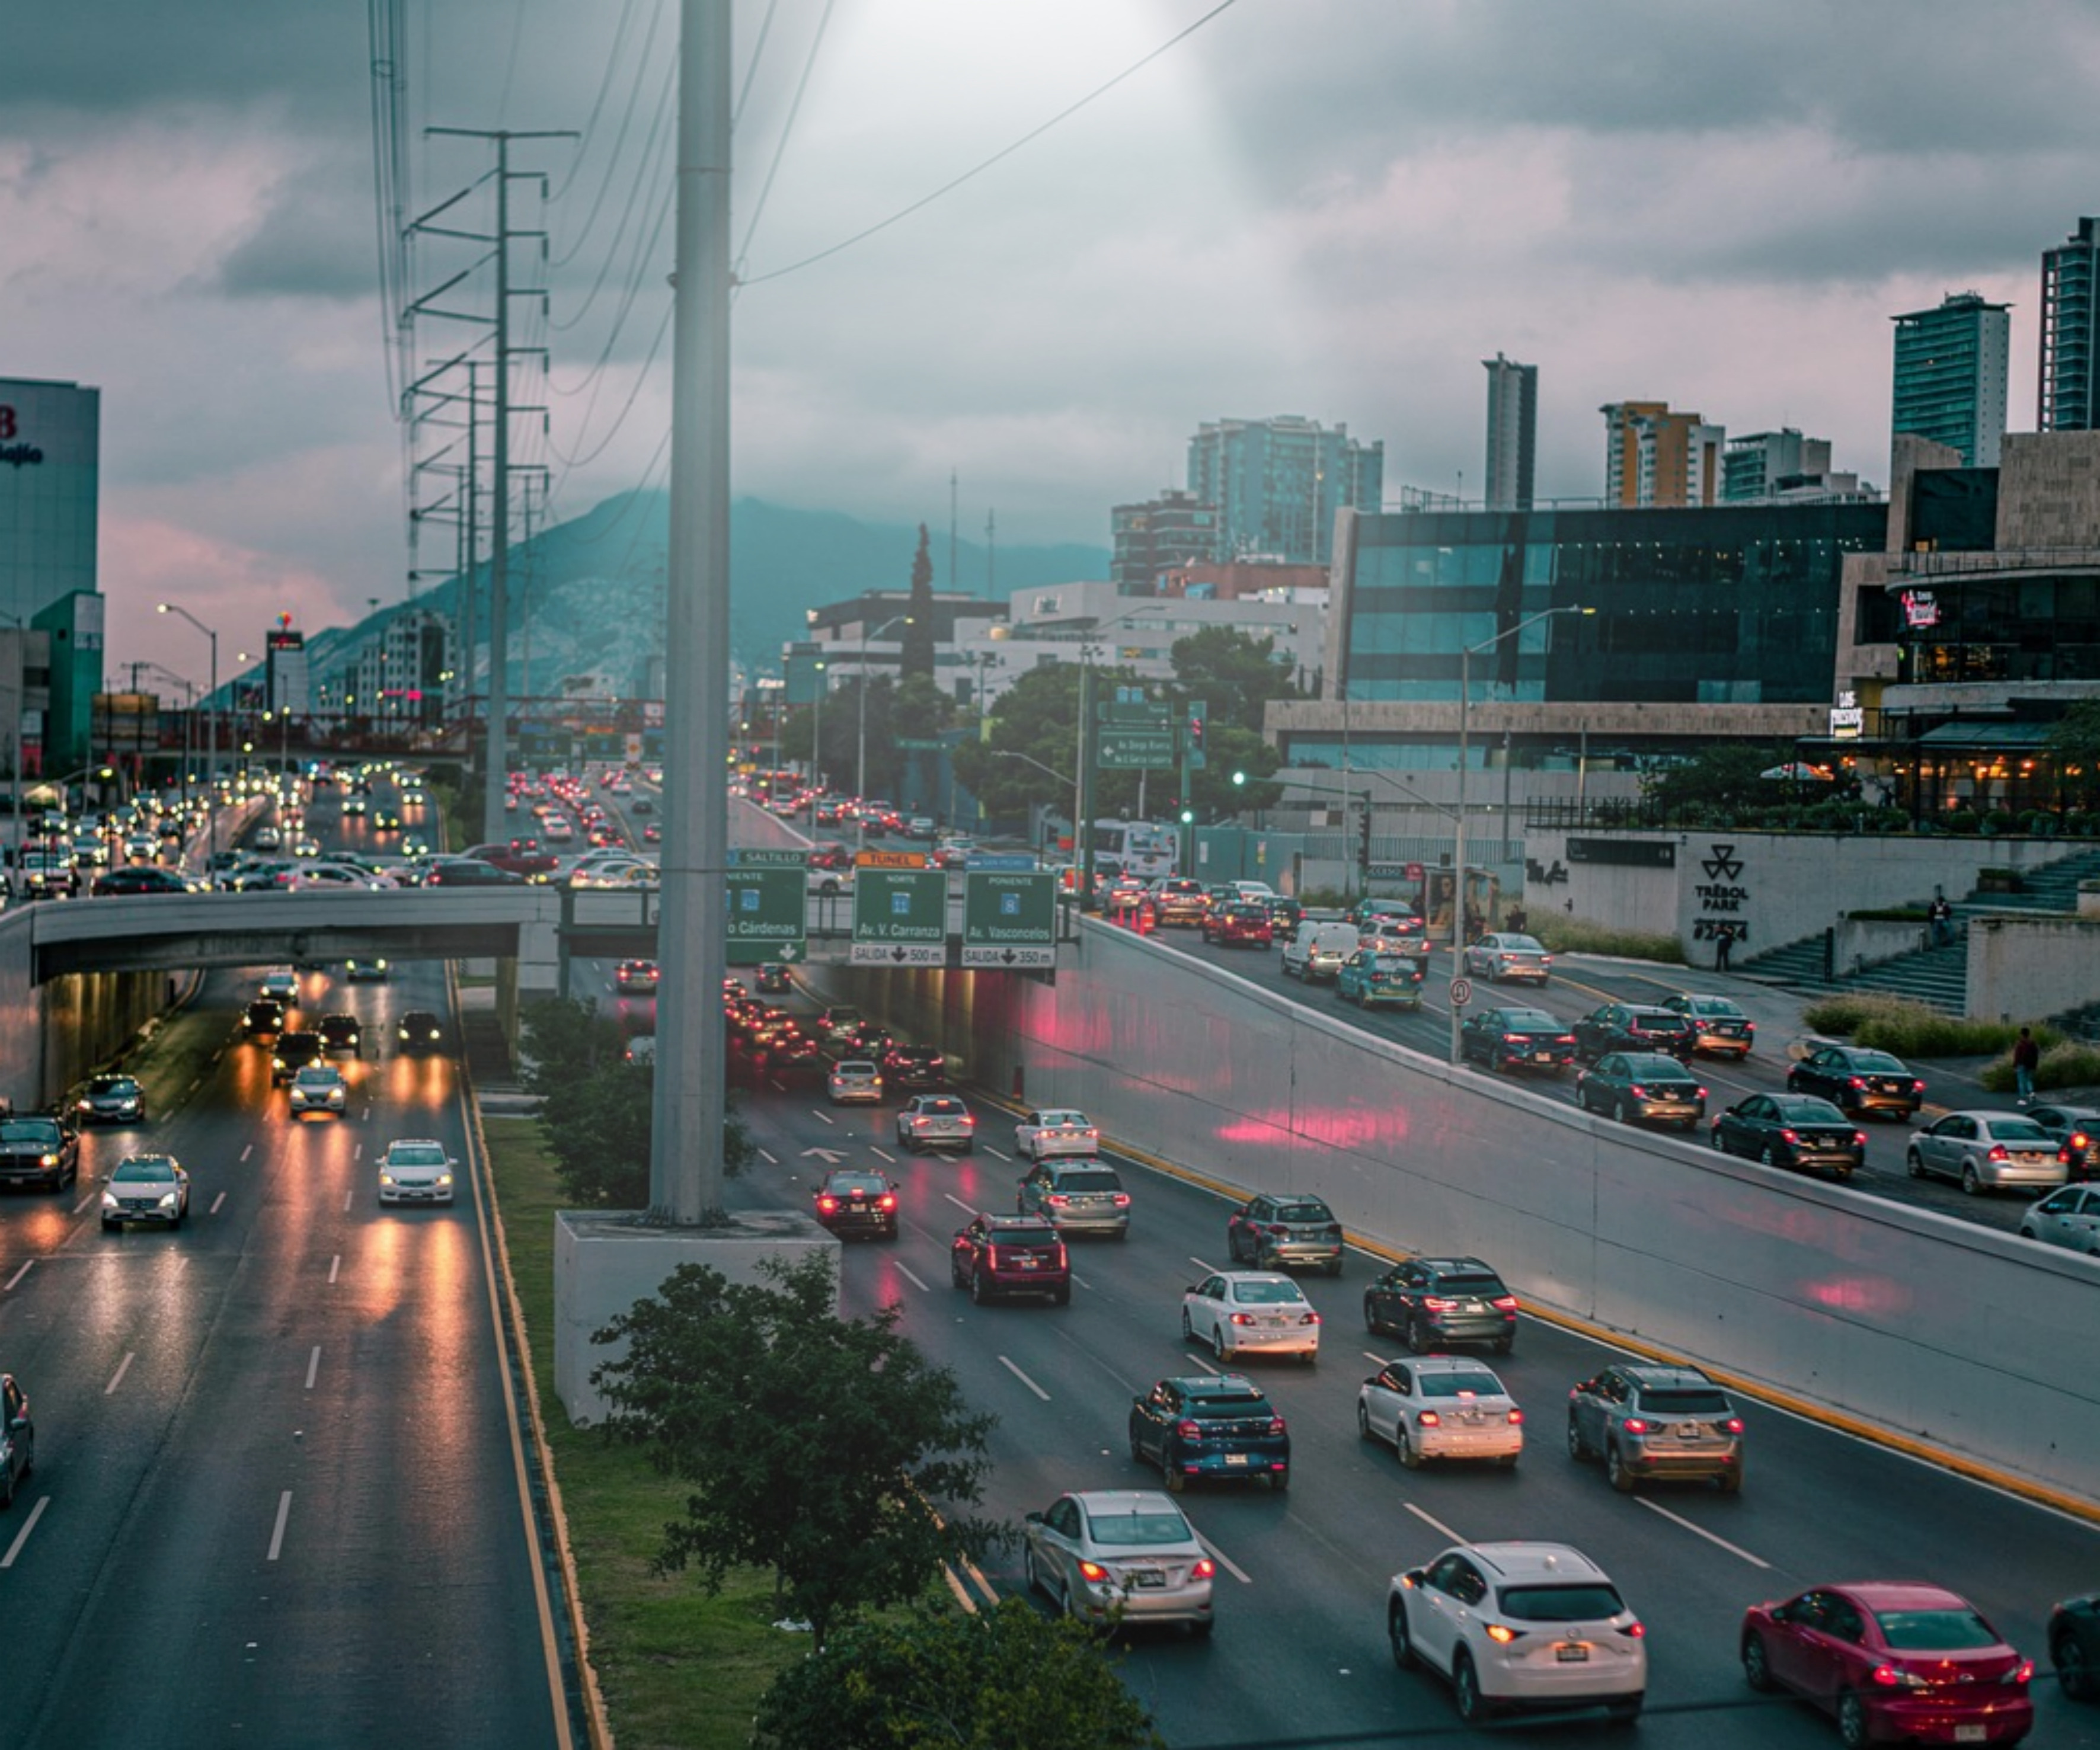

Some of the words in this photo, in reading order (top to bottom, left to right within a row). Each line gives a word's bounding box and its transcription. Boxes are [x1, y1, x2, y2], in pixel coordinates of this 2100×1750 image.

[746, 852, 801, 862] SALTILLO
[726, 872, 763, 882] NIENTE
[887, 875, 917, 884] NORTE
[989, 876, 1033, 886] PONIENTE
[1005, 899, 1015, 913] 8
[1702, 898, 1739, 912] PARK
[739, 920, 797, 935] Cárdenas
[859, 923, 875, 936] Av.
[891, 924, 940, 938] Carranza
[989, 926, 1050, 940] Vasconcelos
[854, 948, 888, 960] SALIDA
[910, 949, 929, 961] 500
[964, 950, 999, 962] SALIDA
[1019, 951, 1038, 963] 350
